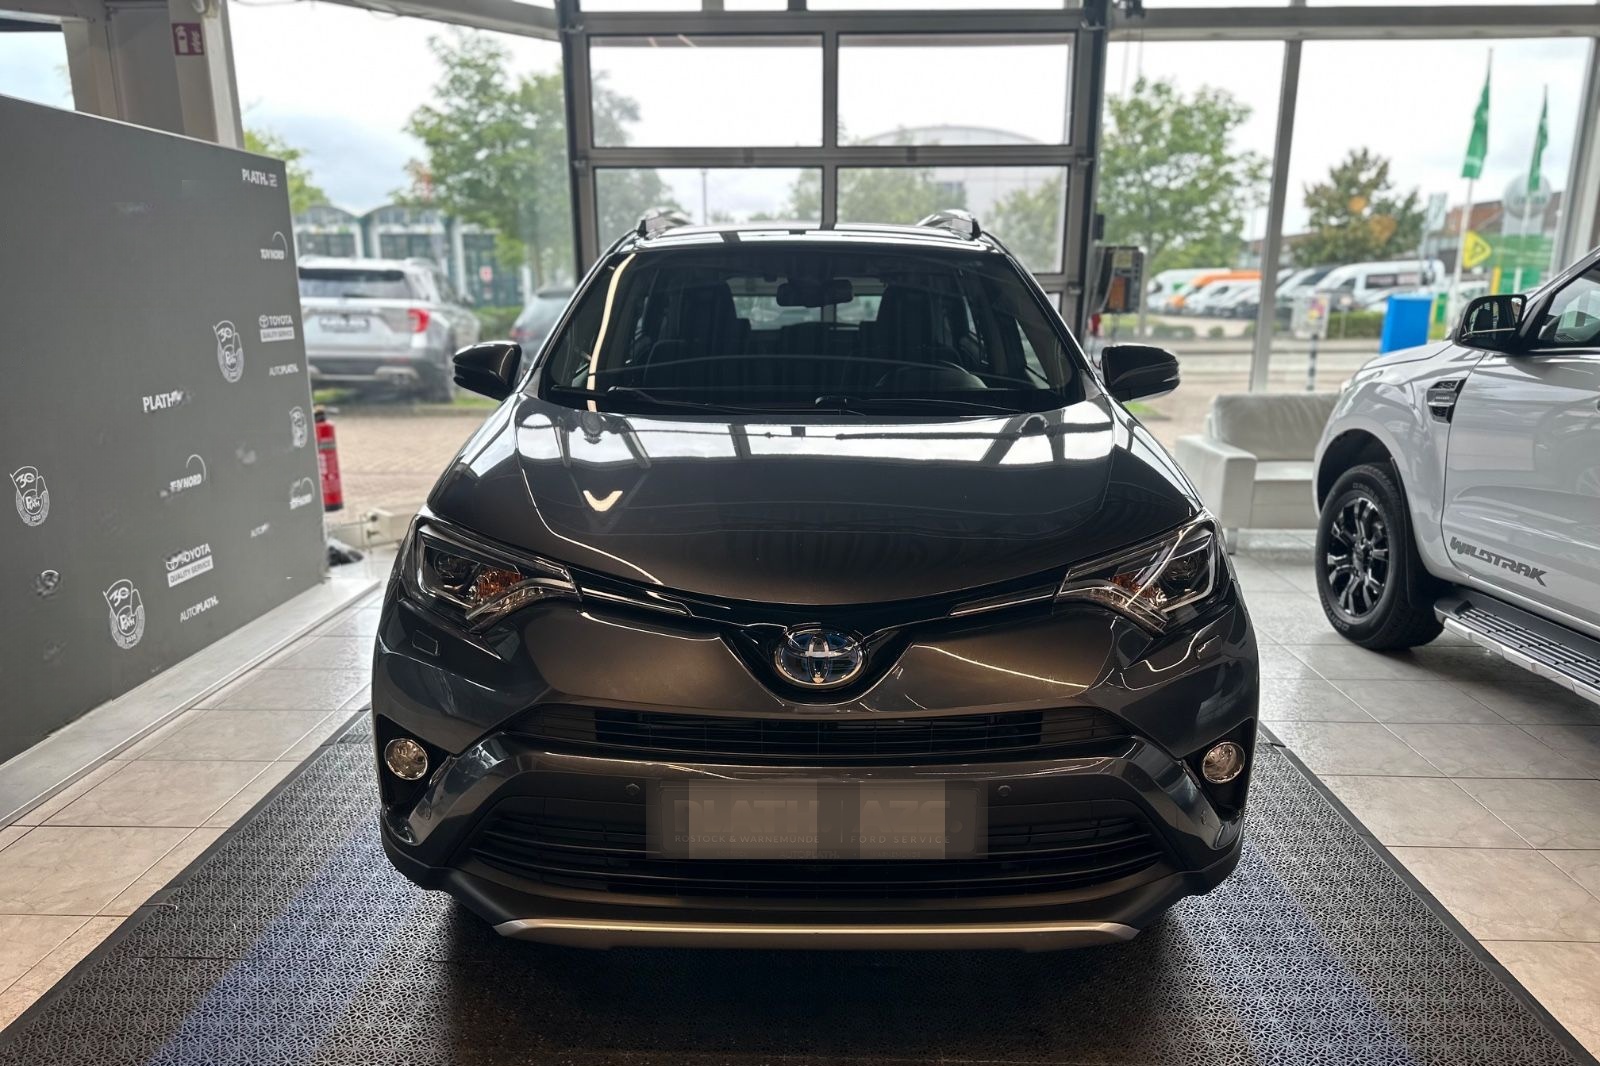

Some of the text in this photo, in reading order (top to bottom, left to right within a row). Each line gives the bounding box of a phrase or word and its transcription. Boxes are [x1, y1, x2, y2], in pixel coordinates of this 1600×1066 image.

[268, 315, 294, 326] TOYOTA
[16, 473, 36, 489] 30
[169, 568, 191, 583] QUALITY
[109, 587, 130, 607] 30
[674, 835, 725, 844] ROSTOCK
[728, 835, 737, 844] &
[850, 835, 951, 844] FORD SERVICE
